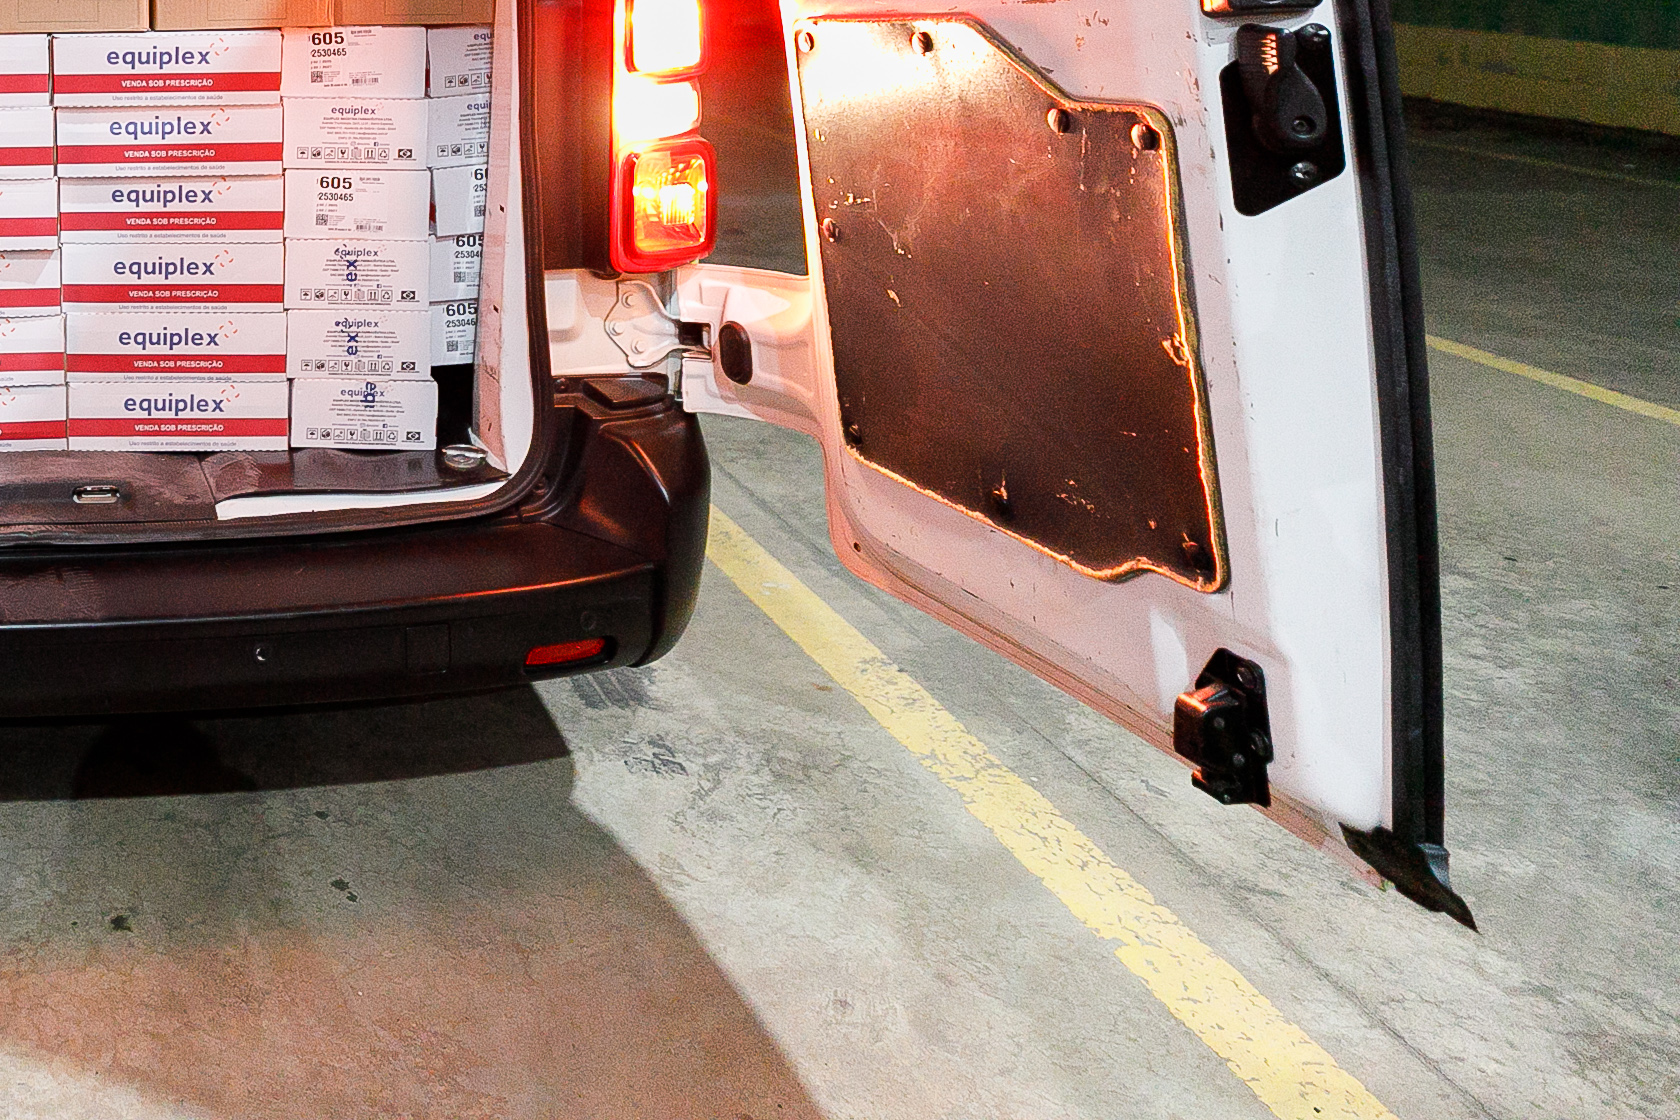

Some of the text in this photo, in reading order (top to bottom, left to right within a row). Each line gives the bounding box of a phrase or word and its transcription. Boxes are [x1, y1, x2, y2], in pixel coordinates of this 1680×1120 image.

[311, 32, 344, 45] 605
[106, 46, 211, 70] equiplex
[311, 48, 347, 57] 2530465
[121, 78, 213, 88] VENDA SOB PRESCRIÇÃO
[331, 105, 376, 116] equiplex
[109, 116, 212, 140] equiplex
[124, 149, 215, 158] VENDA SOB PRESCRIÇÃO
[320, 176, 352, 189] 605
[111, 185, 213, 207] equiplex
[318, 192, 354, 201] 2530465
[126, 217, 216, 226] VENDA SOB PRESCRIÇÃO
[113, 257, 214, 280] equiplex
[129, 290, 218, 298] VENDA SOB PRESCRIÇÃO
[446, 303, 477, 316] 605
[118, 328, 219, 350] equiplex
[134, 360, 223, 369] VENDA SOB PRESCRIÇÃO
[123, 393, 224, 416] equiplex
[135, 424, 223, 433] VENDA SOB PRESCRIÇÃO
